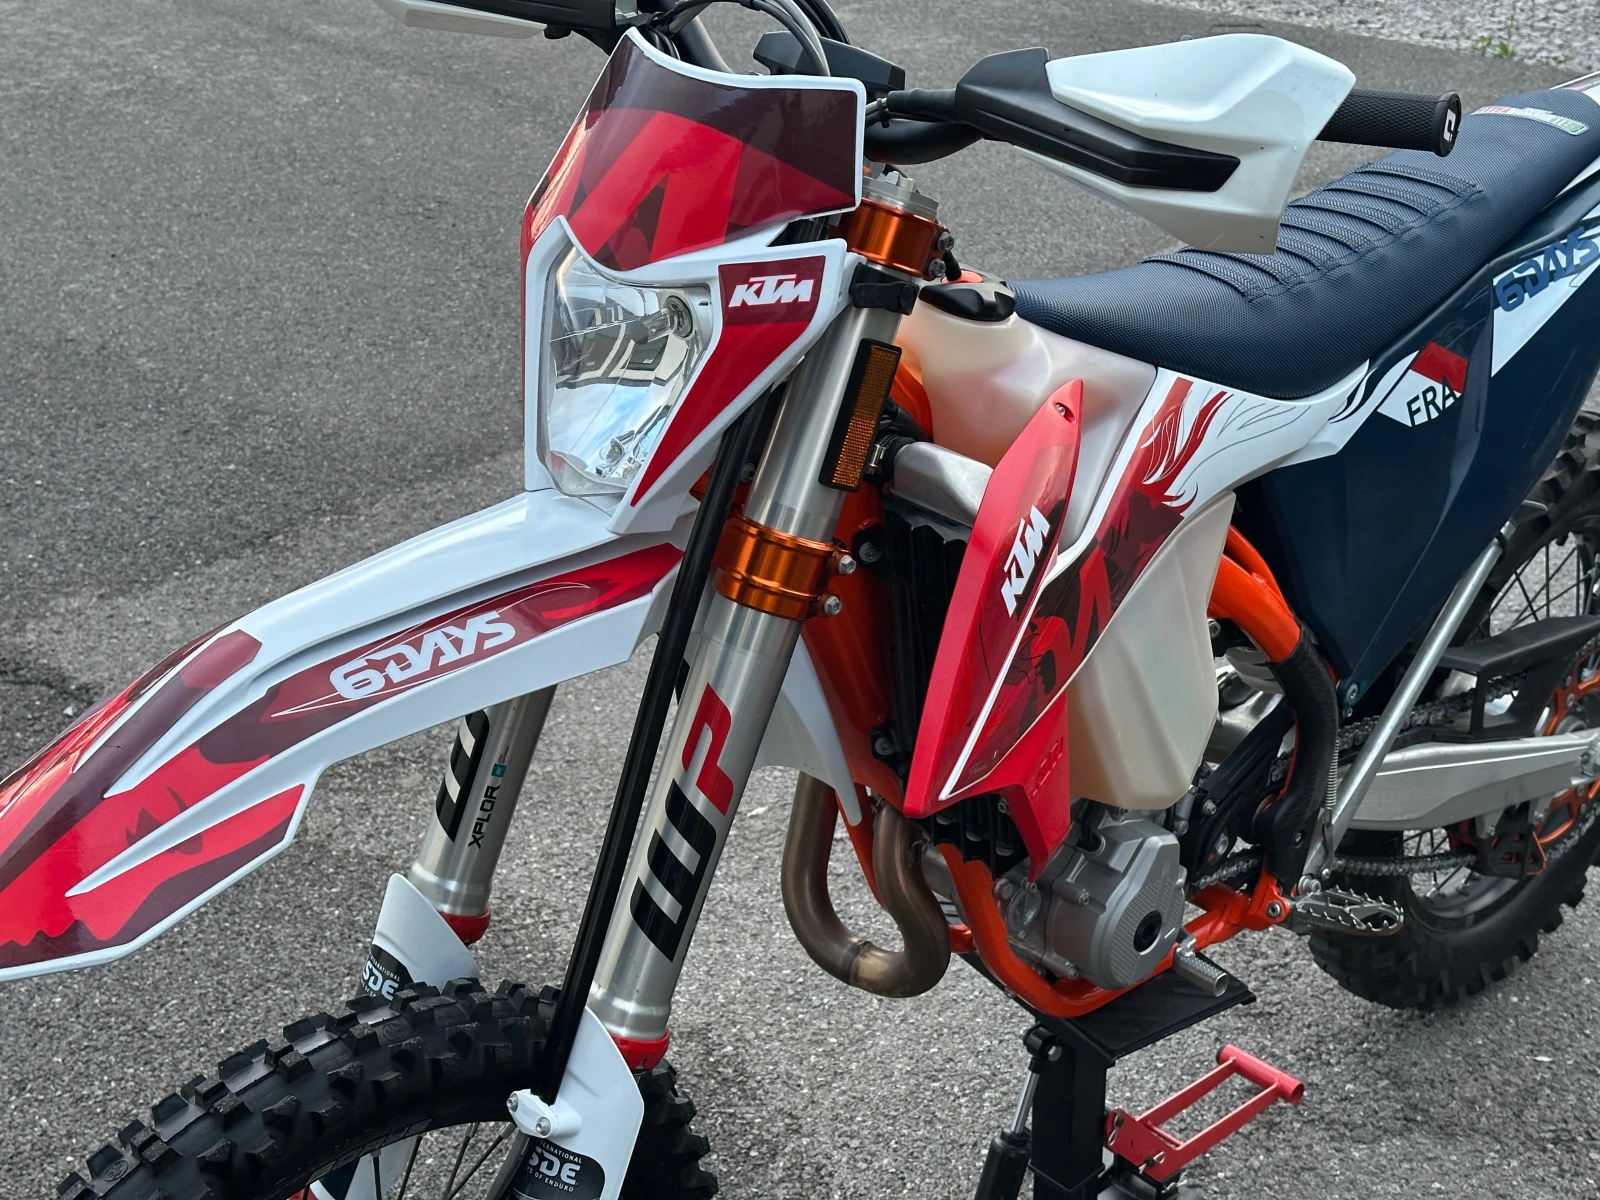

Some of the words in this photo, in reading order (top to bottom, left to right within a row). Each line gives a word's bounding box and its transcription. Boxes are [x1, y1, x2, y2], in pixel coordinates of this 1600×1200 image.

[728, 273, 814, 308] KTM
[1495, 226, 1600, 312] 6DAYS
[1406, 375, 1458, 428] FRA
[1000, 504, 1051, 618] KTM
[329, 610, 516, 699] 6DAYS
[467, 784, 501, 849] XPLOR
[539, 1139, 583, 1164] TERNATIONAL
[534, 1171, 543, 1180] OF
[544, 1177, 574, 1193] ENDURO
